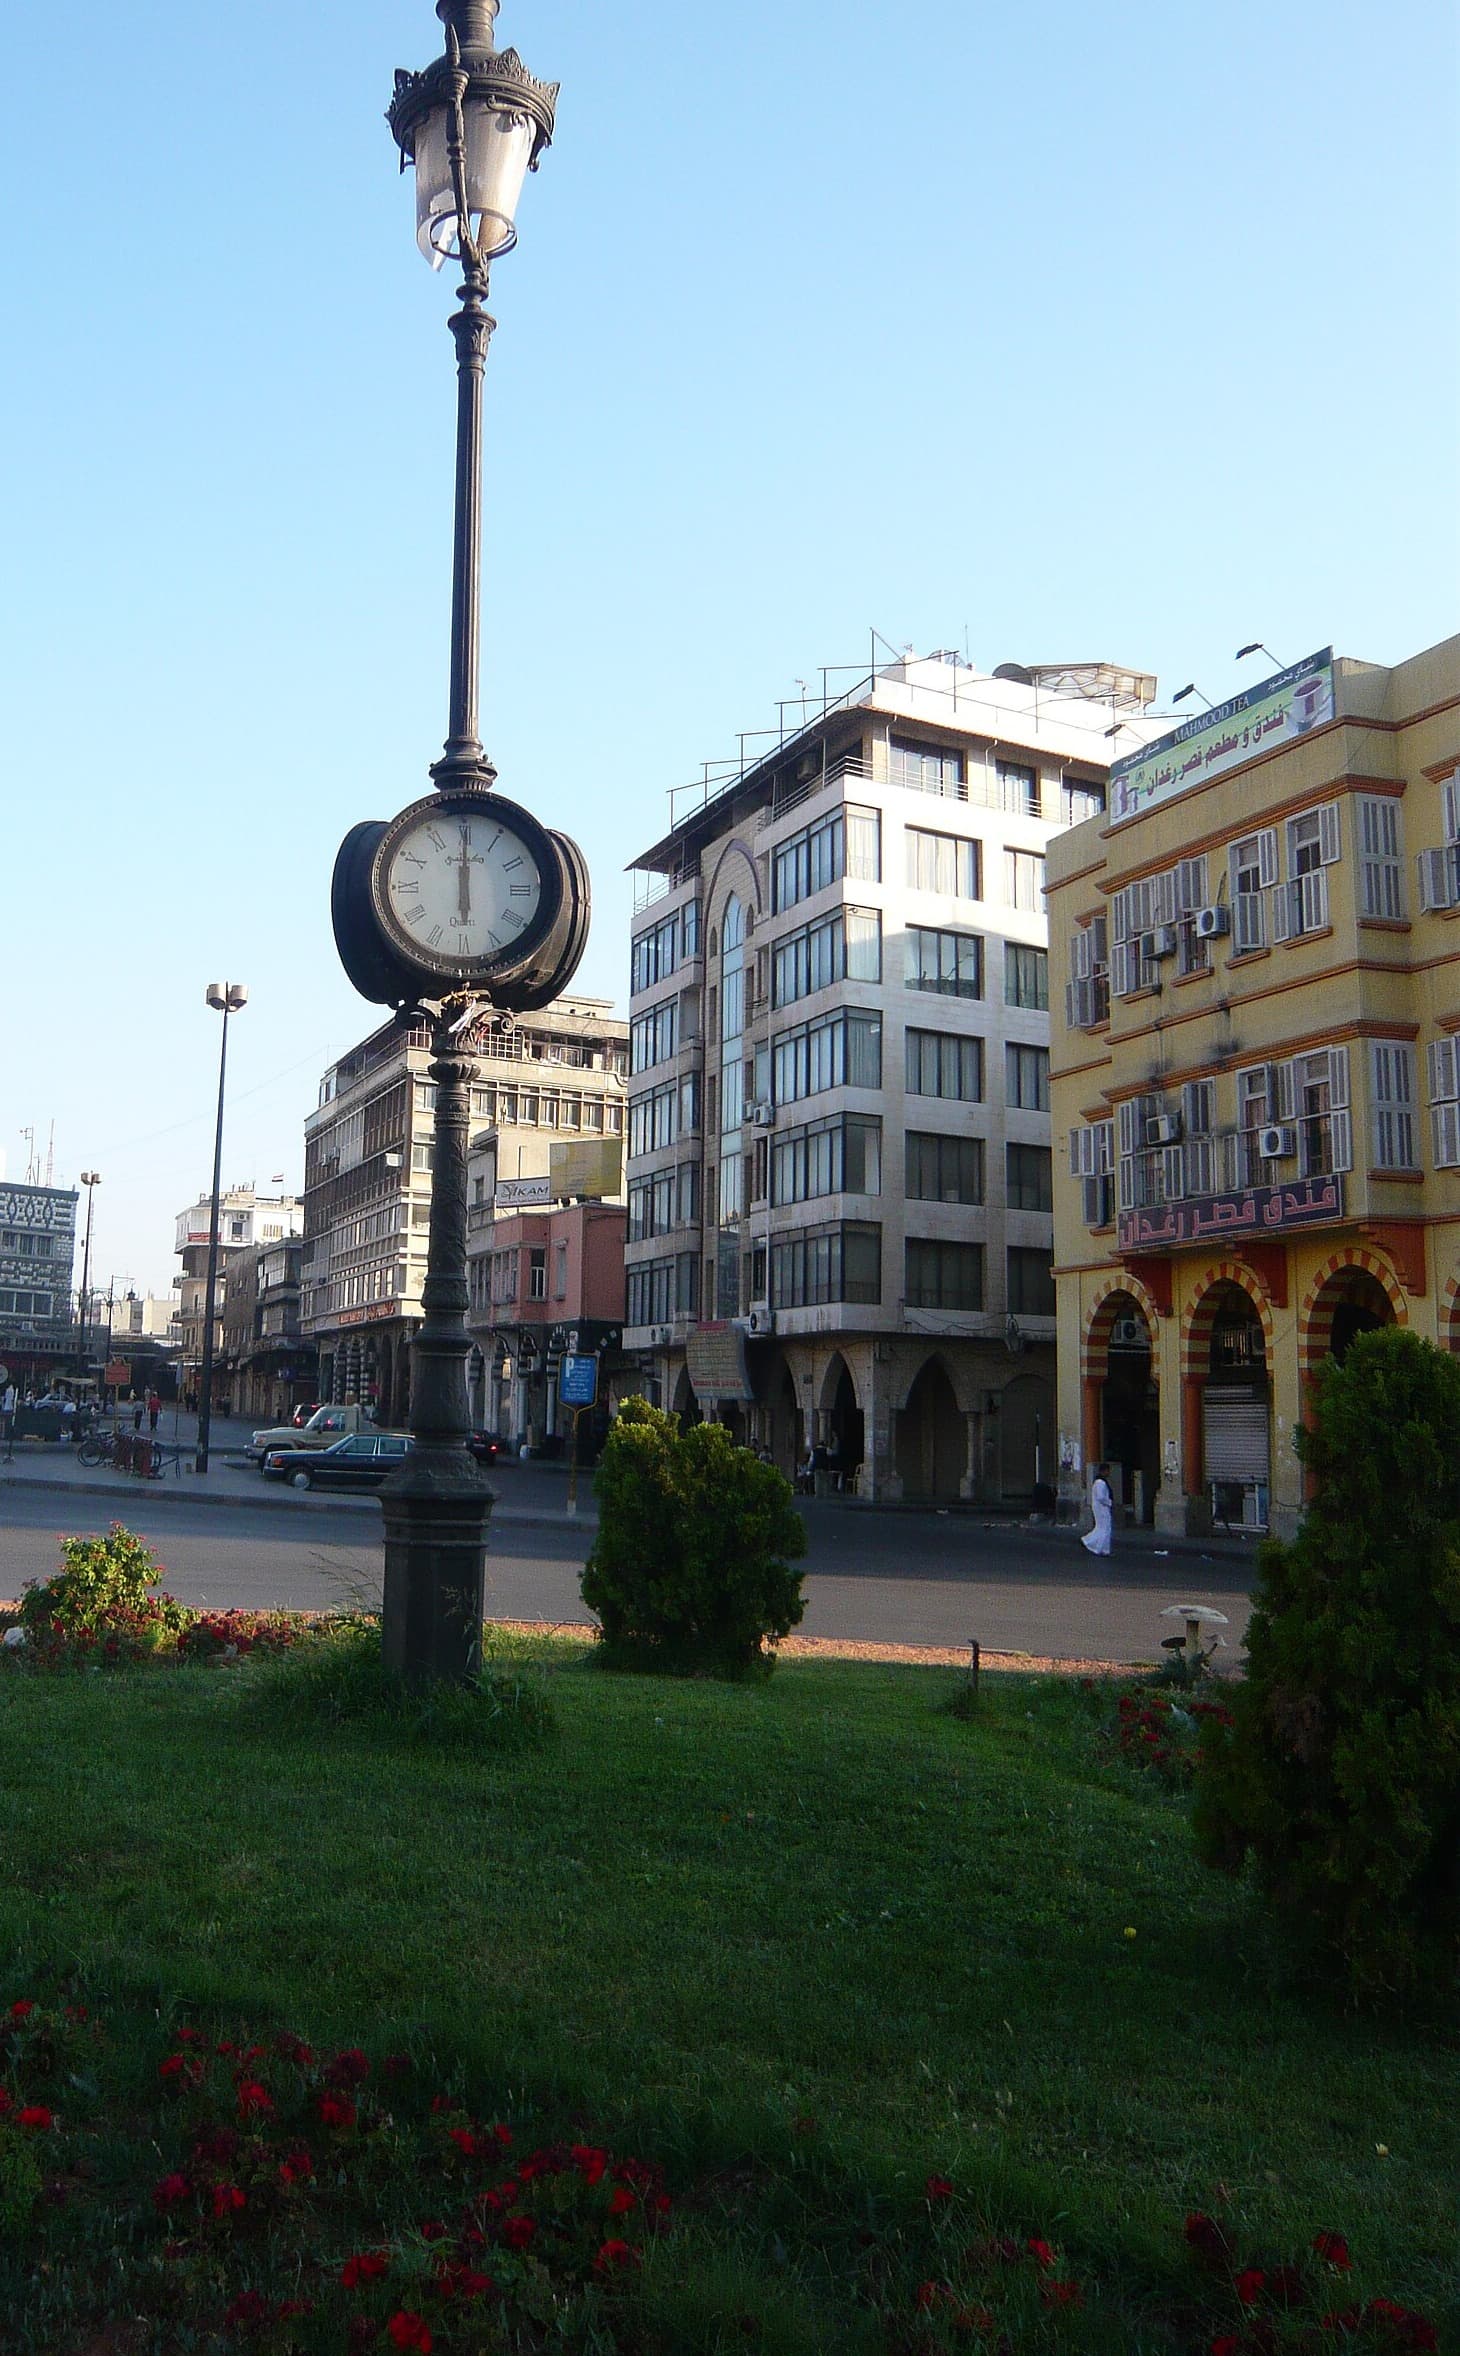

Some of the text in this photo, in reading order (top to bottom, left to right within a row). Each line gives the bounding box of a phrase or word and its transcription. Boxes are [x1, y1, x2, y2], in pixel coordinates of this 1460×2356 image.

[1174, 695, 1250, 744] MAHMOOD TEA
[1253, 703, 1284, 744] فندق
[1192, 1189, 1256, 1237] قصر
[1263, 1177, 1336, 1225] فندق
[565, 1357, 575, 1378] P
